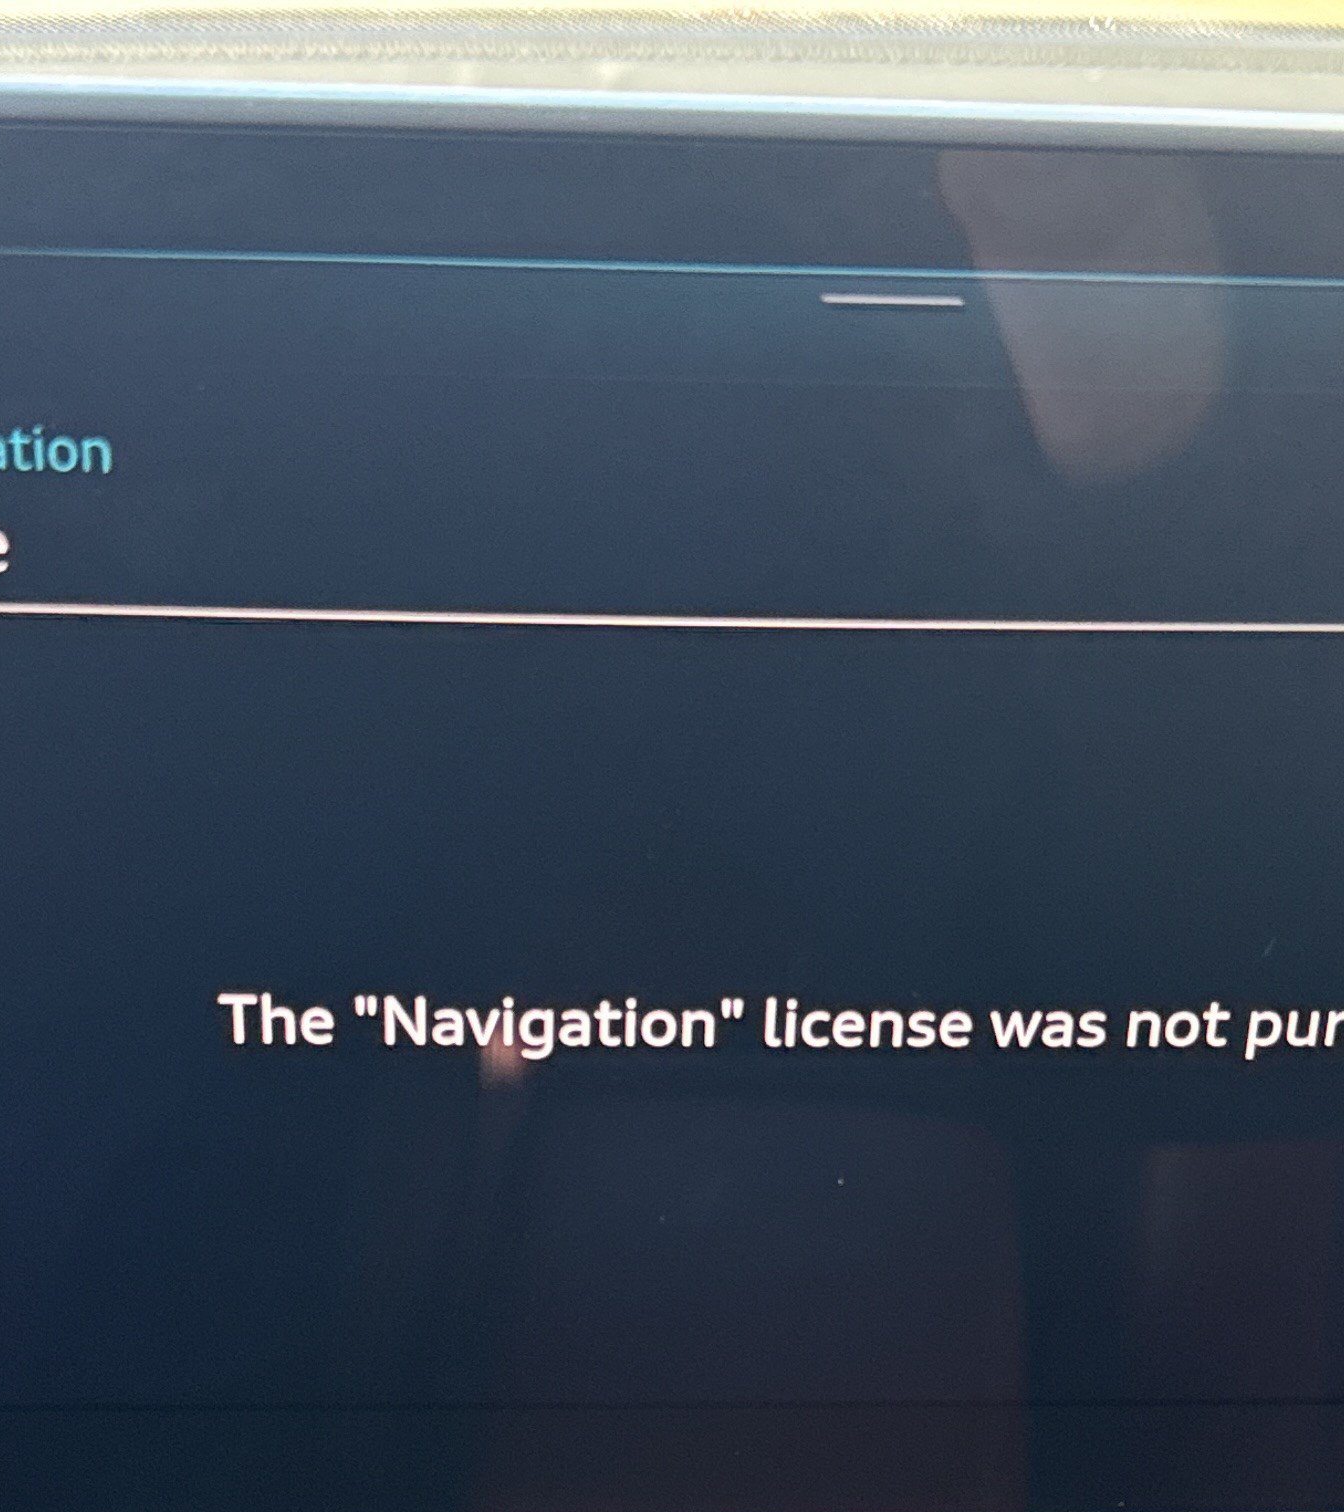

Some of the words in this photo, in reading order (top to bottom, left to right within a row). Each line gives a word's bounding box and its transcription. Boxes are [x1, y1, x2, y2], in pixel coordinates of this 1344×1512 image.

[217, 992, 335, 1046] The
[354, 994, 744, 1060] "Navigation"
[764, 996, 973, 1048] license
[989, 1010, 1107, 1048] was
[1126, 1001, 1231, 1048] not
